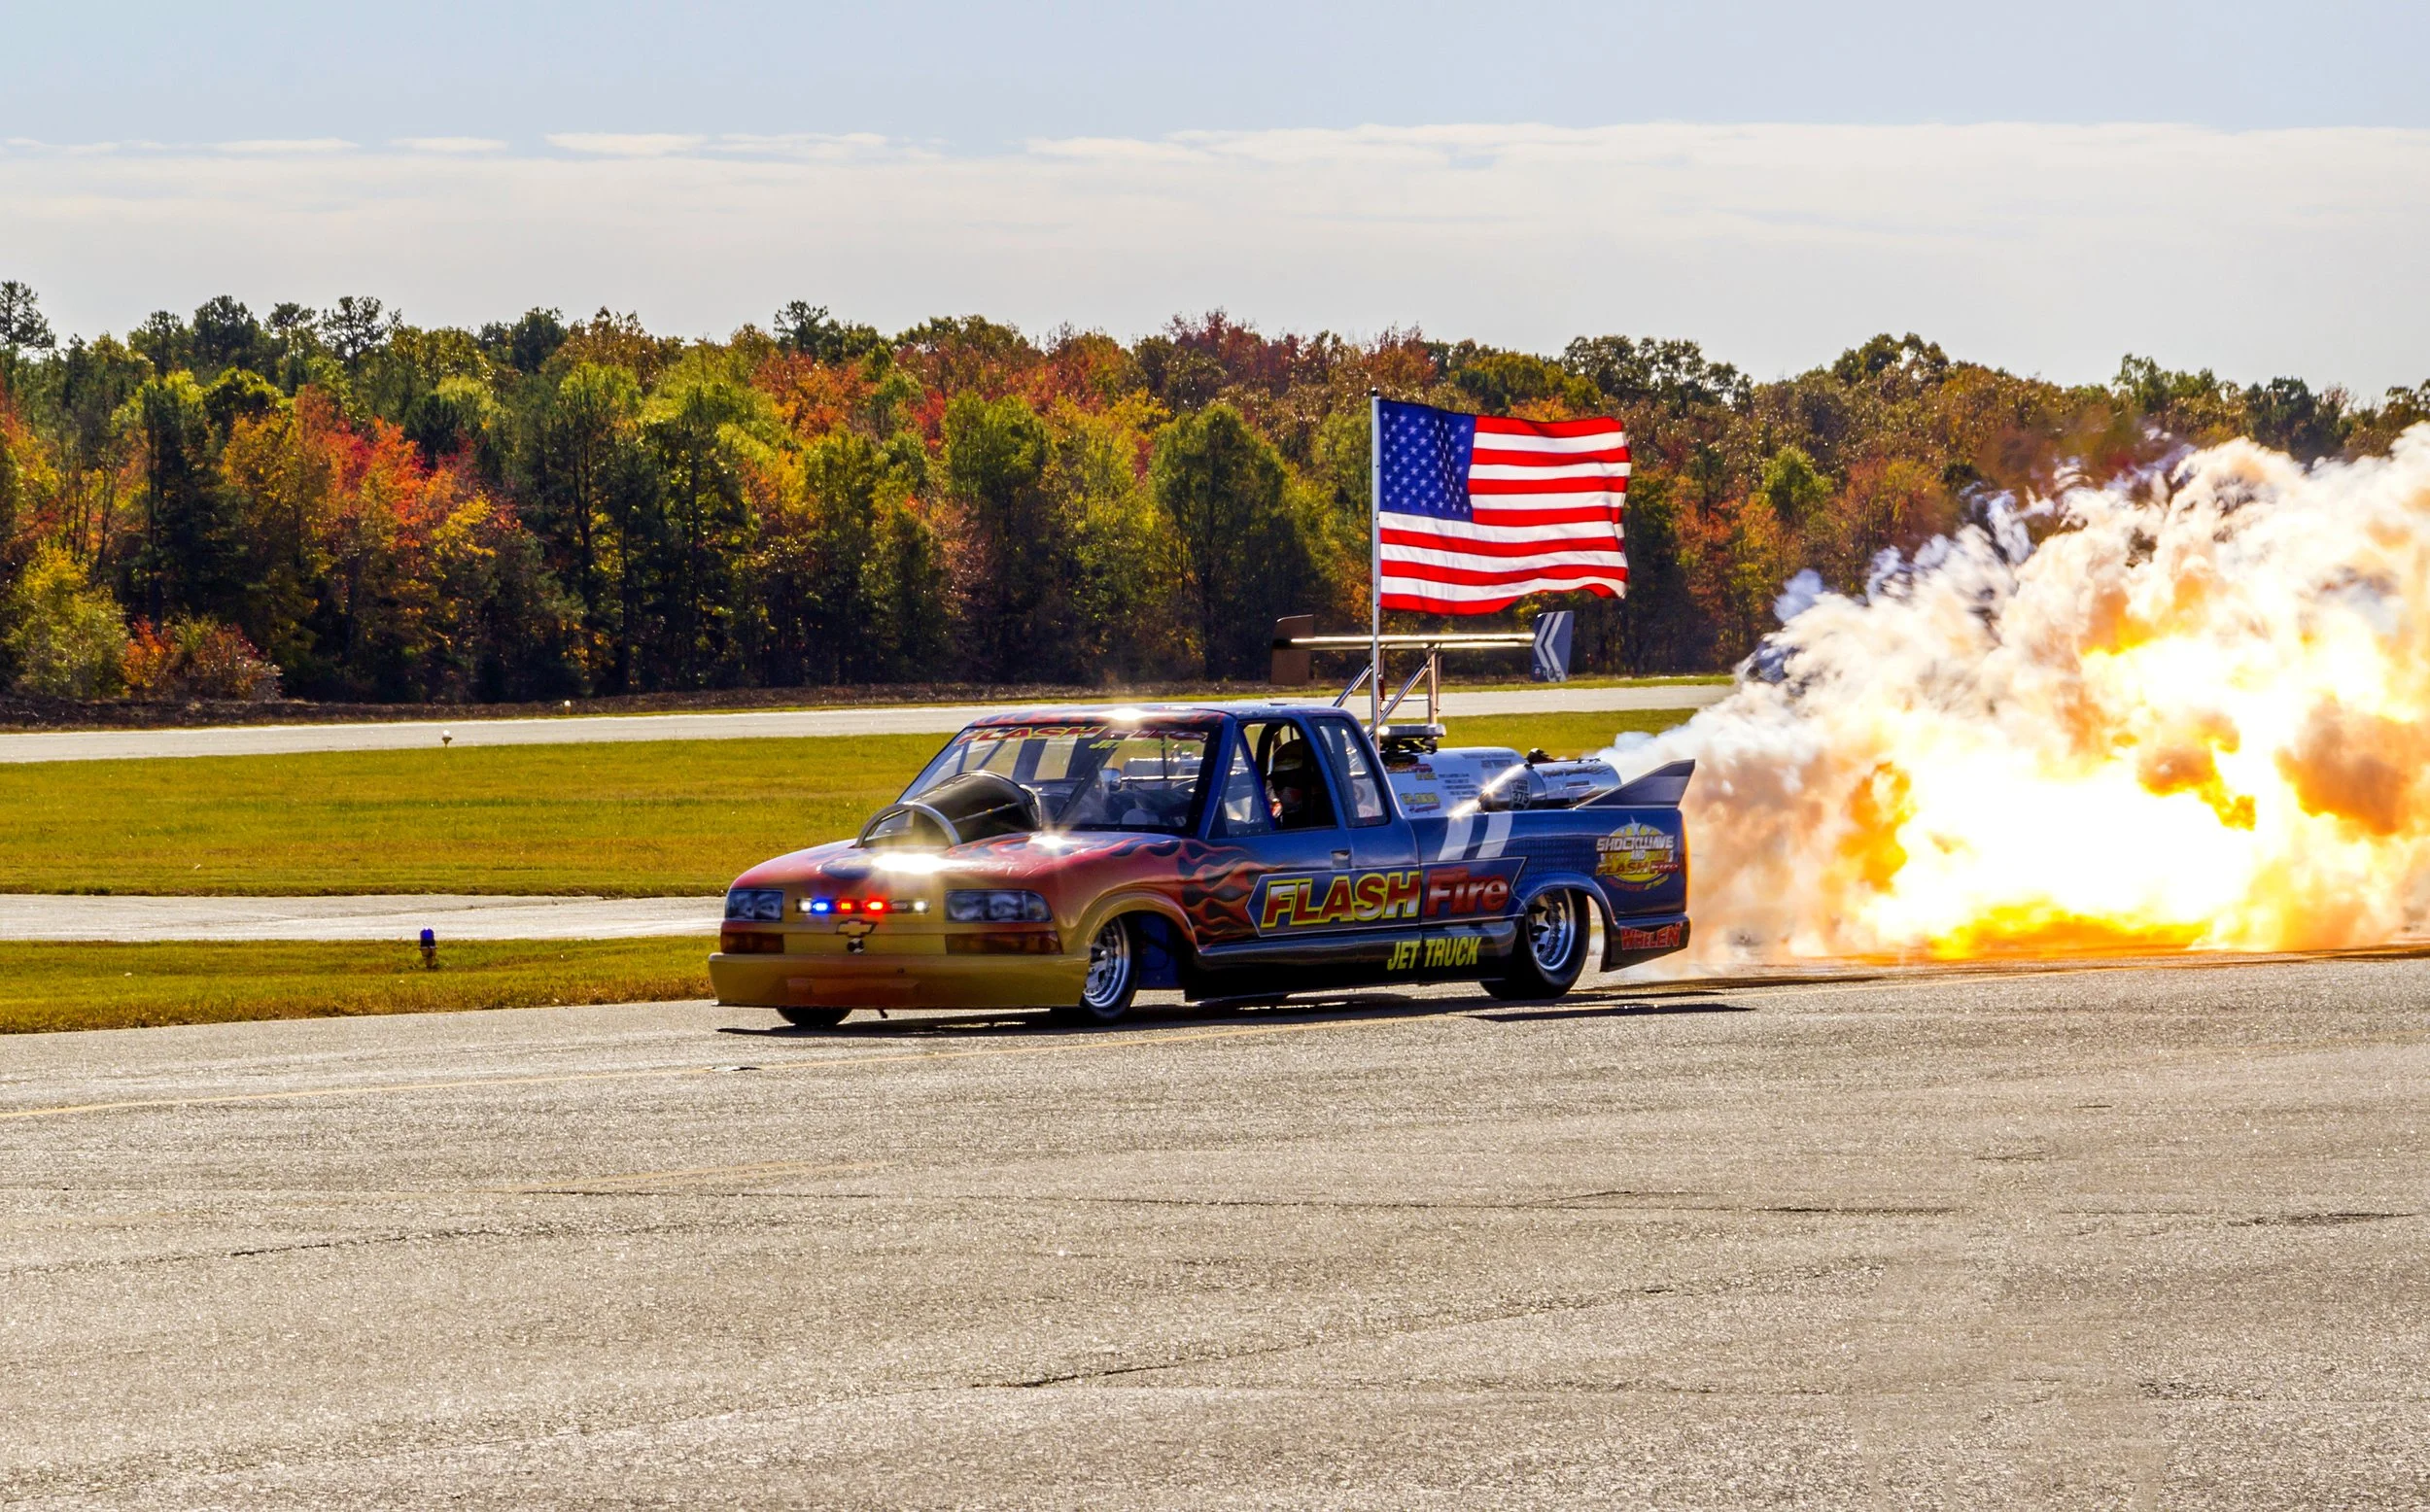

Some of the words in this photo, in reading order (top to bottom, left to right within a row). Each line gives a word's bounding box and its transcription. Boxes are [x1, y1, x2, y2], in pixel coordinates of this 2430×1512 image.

[955, 726, 1108, 747] FLASH
[1511, 790, 1529, 805] 375
[1596, 835, 1674, 851] SHOCKWAVE
[1630, 848, 1647, 861] AND
[1596, 861, 1649, 876] FLASH
[1260, 872, 1423, 929] FLASH
[1423, 868, 1508, 917] Fire
[1620, 923, 1681, 950] WHELEN
[1386, 941, 1422, 971] JET
[1423, 936, 1482, 968] TRUCK
